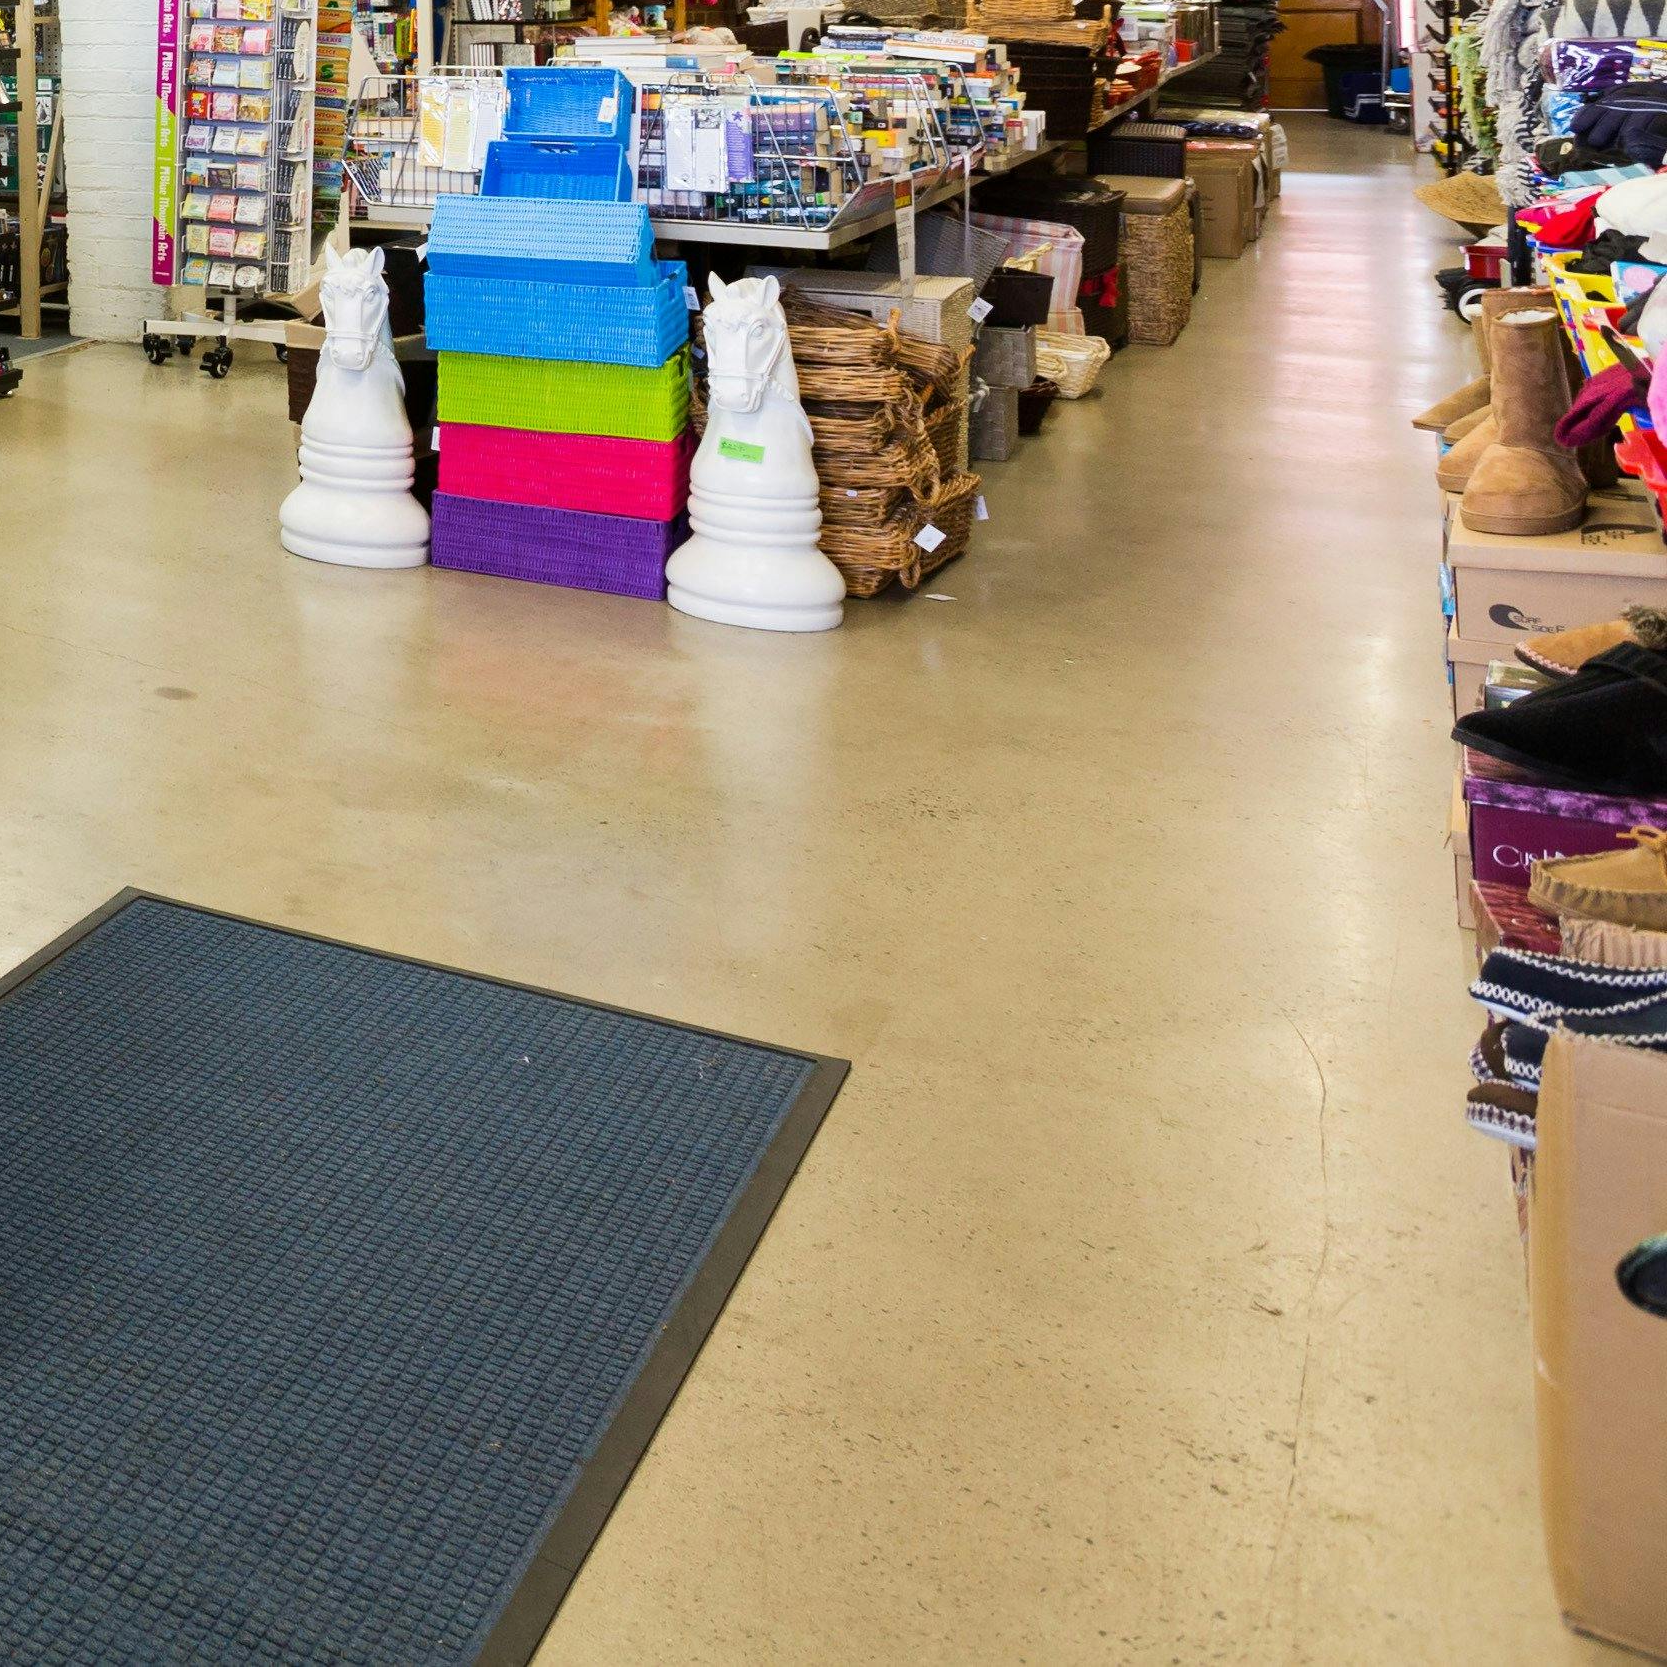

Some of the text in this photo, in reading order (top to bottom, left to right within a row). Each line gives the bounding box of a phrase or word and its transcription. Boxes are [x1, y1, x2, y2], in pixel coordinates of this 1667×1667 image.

[945, 37, 978, 47] ANGELS
[160, 58, 173, 82] Blue
[159, 82, 172, 128] Mountain
[158, 172, 171, 197] Blue
[157, 196, 170, 240] Mountain
